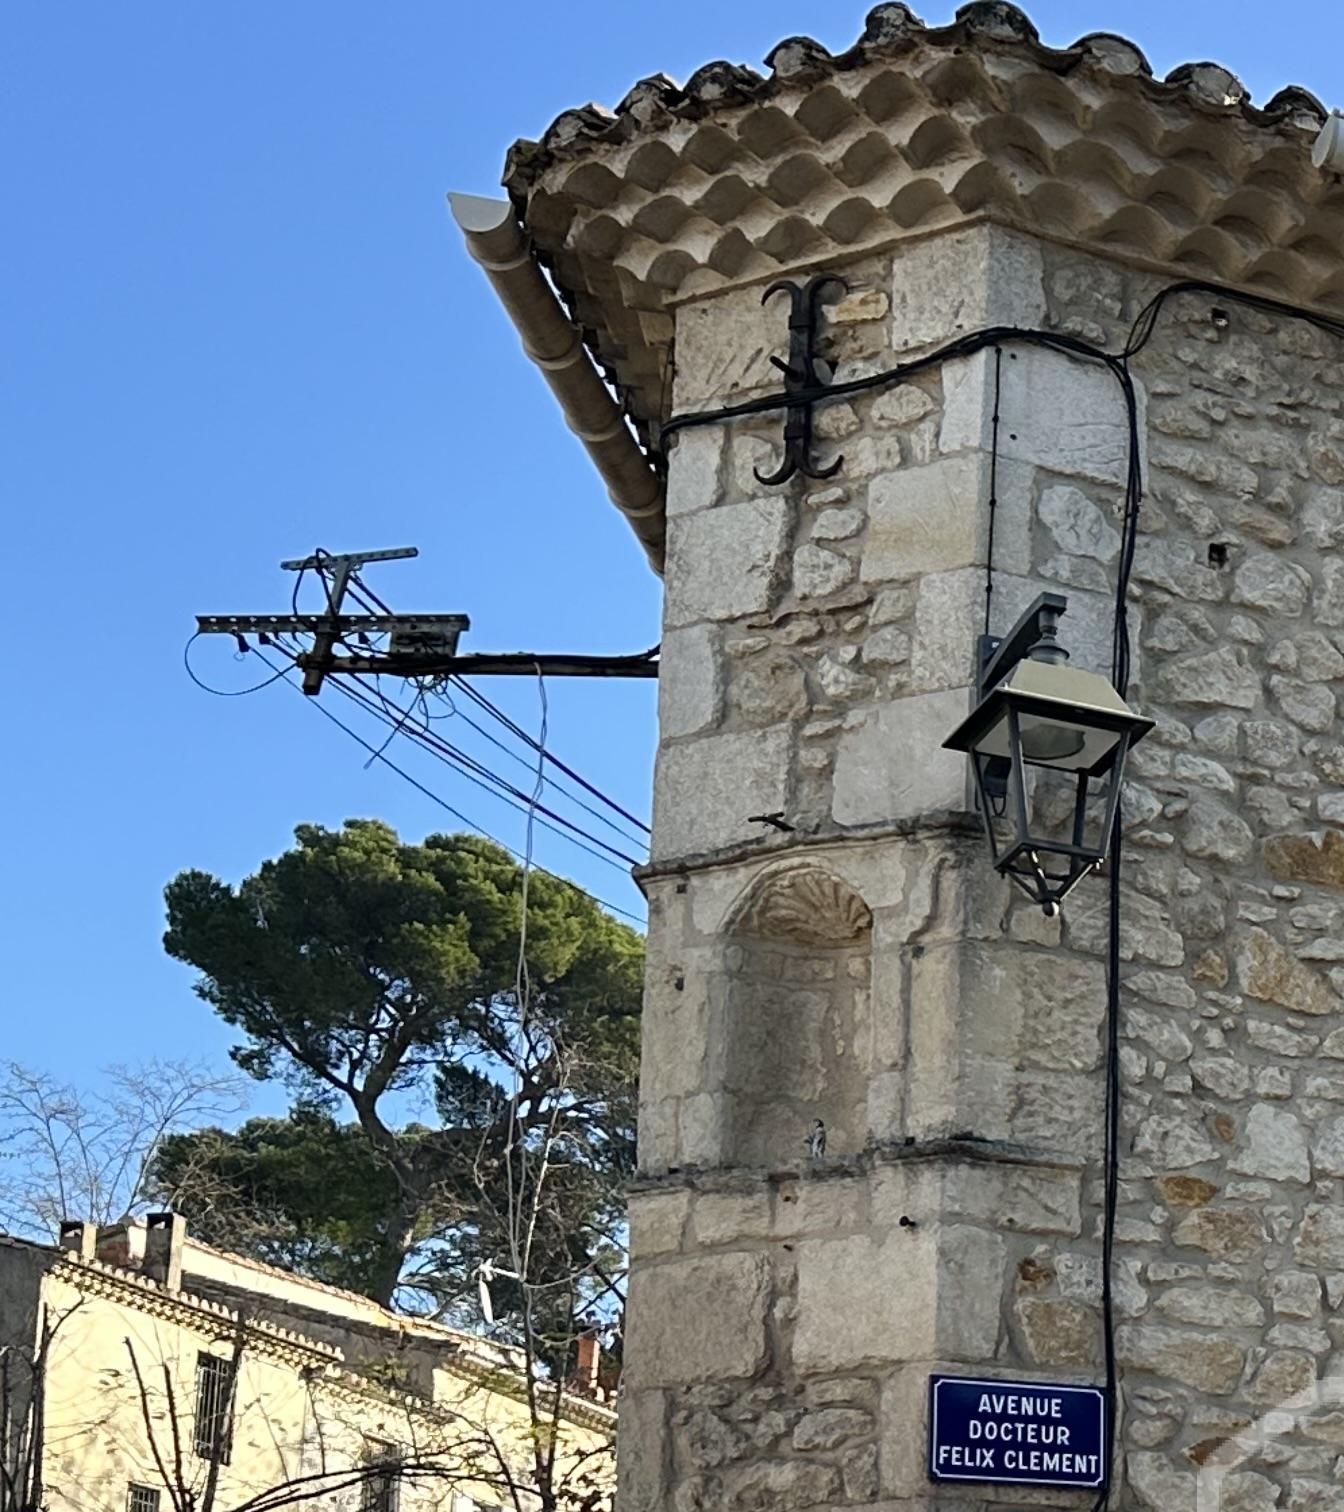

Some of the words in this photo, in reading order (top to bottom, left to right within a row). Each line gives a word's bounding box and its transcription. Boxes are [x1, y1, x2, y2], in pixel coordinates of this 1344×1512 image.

[978, 1393, 1062, 1418] AVENUE
[969, 1419, 1070, 1446] DOCTEUR
[938, 1445, 995, 1468] FELIX
[1004, 1450, 1099, 1474] CLEMENT
